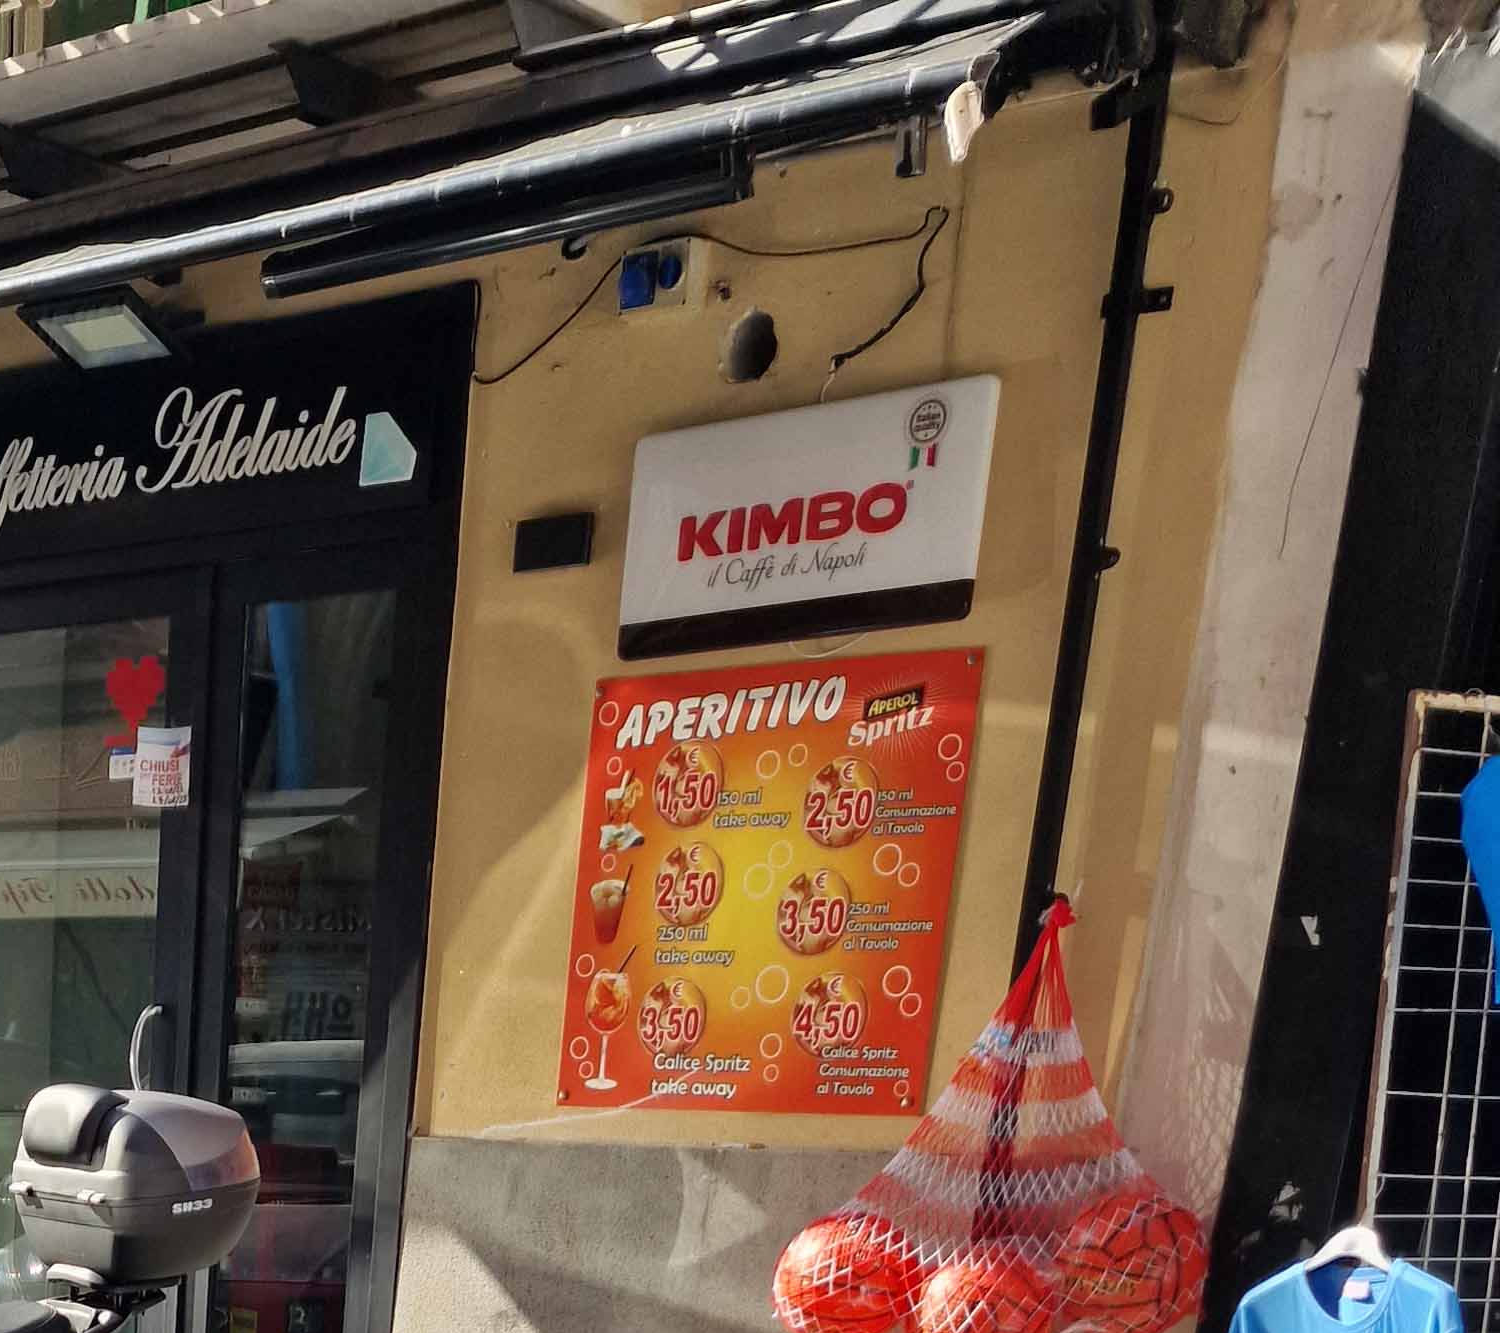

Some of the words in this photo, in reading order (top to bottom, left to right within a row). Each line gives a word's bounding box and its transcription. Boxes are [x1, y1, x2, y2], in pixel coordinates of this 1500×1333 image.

[134, 385, 357, 493] Adelaide
[676, 481, 908, 563] KIMBO
[707, 562, 722, 588] il
[780, 552, 797, 577] di
[801, 541, 868, 582] Napoli
[615, 675, 847, 750] APERITIVO
[867, 690, 919, 717] APEROL
[847, 705, 934, 747] Spritz
[140, 759, 179, 773] CHIUSI
[657, 769, 717, 821] 1,50
[717, 791, 739, 806] 150
[741, 786, 763, 805] ml
[876, 791, 896, 802] 150
[898, 788, 914, 801] ml
[713, 811, 748, 828] take
[750, 812, 791, 828] away
[805, 787, 875, 840] 2,50
[875, 804, 957, 818] Consumazione
[872, 824, 883, 835] al
[887, 822, 925, 835] Tavolo
[656, 870, 718, 919] 2,50
[848, 903, 869, 914] 250
[874, 901, 890, 914] ml
[779, 896, 847, 946] 3,50
[846, 920, 933, 933] Consumazione
[658, 926, 685, 941] 250
[688, 924, 708, 940] ml
[844, 938, 855, 950] al
[859, 937, 899, 950] Tavolo
[655, 948, 689, 964] take
[692, 950, 733, 966] away
[640, 1005, 700, 1050] 3,50
[792, 1001, 861, 1049] 4,50
[654, 1053, 700, 1070] Calice
[705, 1054, 751, 1073] Spritz
[821, 1046, 859, 1059] Calice
[862, 1046, 899, 1061] Spritz
[819, 1063, 909, 1078] Consumazione
[651, 1078, 689, 1095] take
[691, 1082, 737, 1099] away
[817, 1083, 829, 1094] al
[833, 1082, 874, 1095] Tavolo
